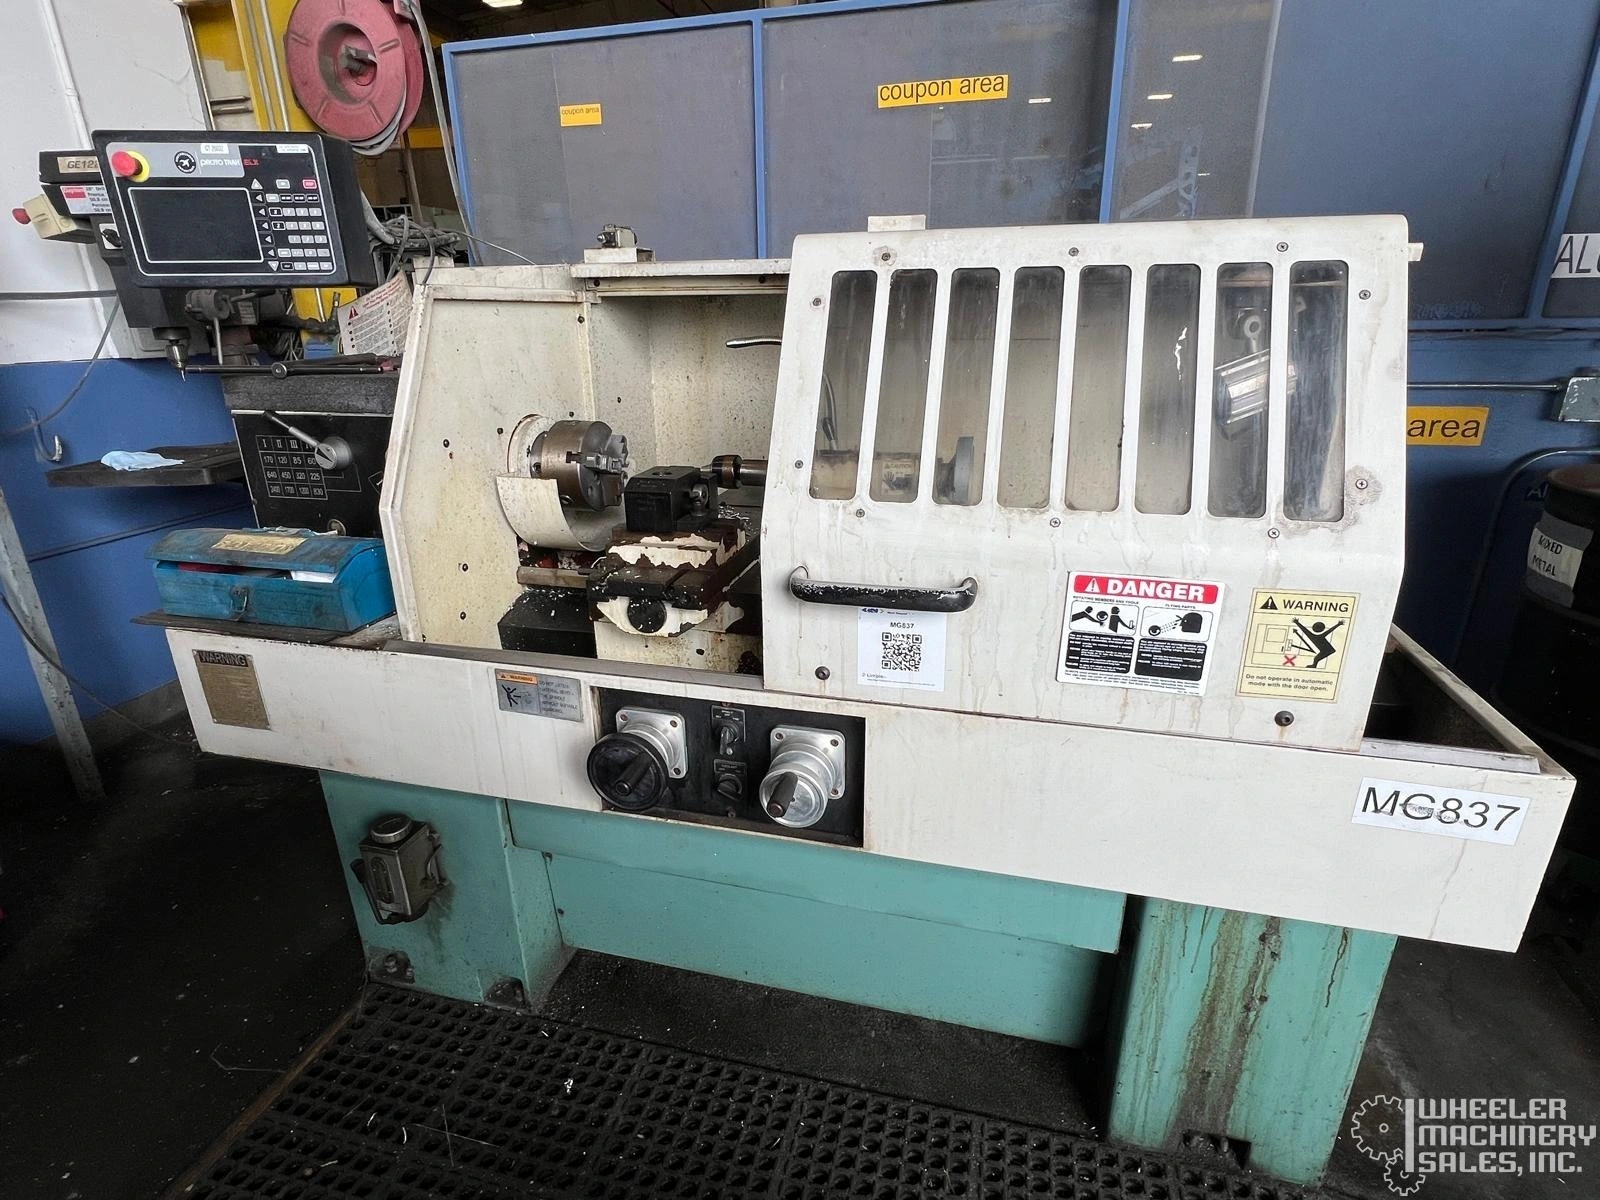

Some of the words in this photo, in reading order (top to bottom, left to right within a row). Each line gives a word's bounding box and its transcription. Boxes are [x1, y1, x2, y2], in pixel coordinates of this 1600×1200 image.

[879, 80, 952, 103] coupon
[959, 75, 1004, 95] area
[1551, 235, 1600, 274] AL
[1407, 418, 1481, 438] area
[1532, 554, 1556, 577] METAL
[1106, 578, 1205, 602] DANGER
[1282, 599, 1350, 613] WARNING
[889, 621, 915, 629] MG837
[199, 650, 247, 666] WARNING
[1267, 675, 1292, 683] operate
[1301, 678, 1334, 686] automatic
[1361, 786, 1521, 832] MG837
